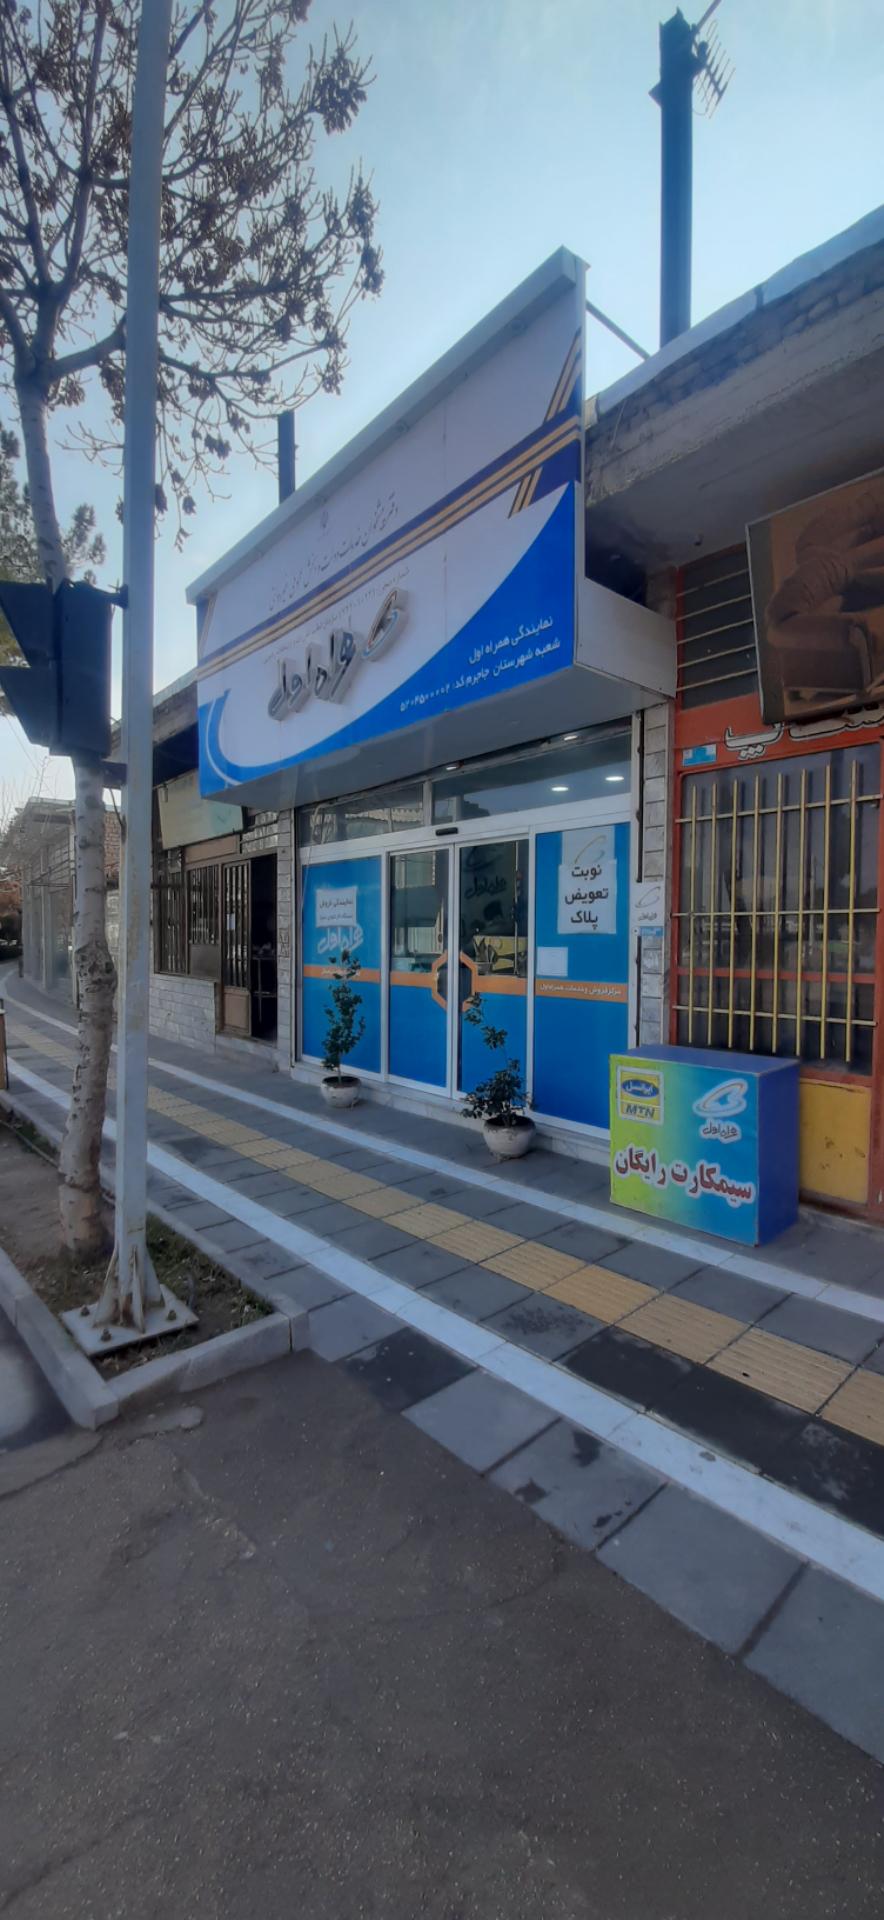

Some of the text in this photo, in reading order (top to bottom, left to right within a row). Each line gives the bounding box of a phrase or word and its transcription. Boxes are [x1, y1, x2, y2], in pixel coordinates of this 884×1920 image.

[468, 616, 554, 664] نمایندگی همراه اول
[535, 637, 561, 659] شعبه
[493, 648, 534, 677] شهرستان
[465, 663, 490, 688] جاجرم
[571, 864, 603, 881] نوبت
[565, 887, 609, 905] تعویض
[570, 910, 599, 931] پلاک
[625, 1080, 655, 1096] ایرانسل
[626, 1103, 656, 1119] MTN
[702, 1120, 721, 1136] اول
[615, 1147, 752, 1203] سیمکارت رایگان
